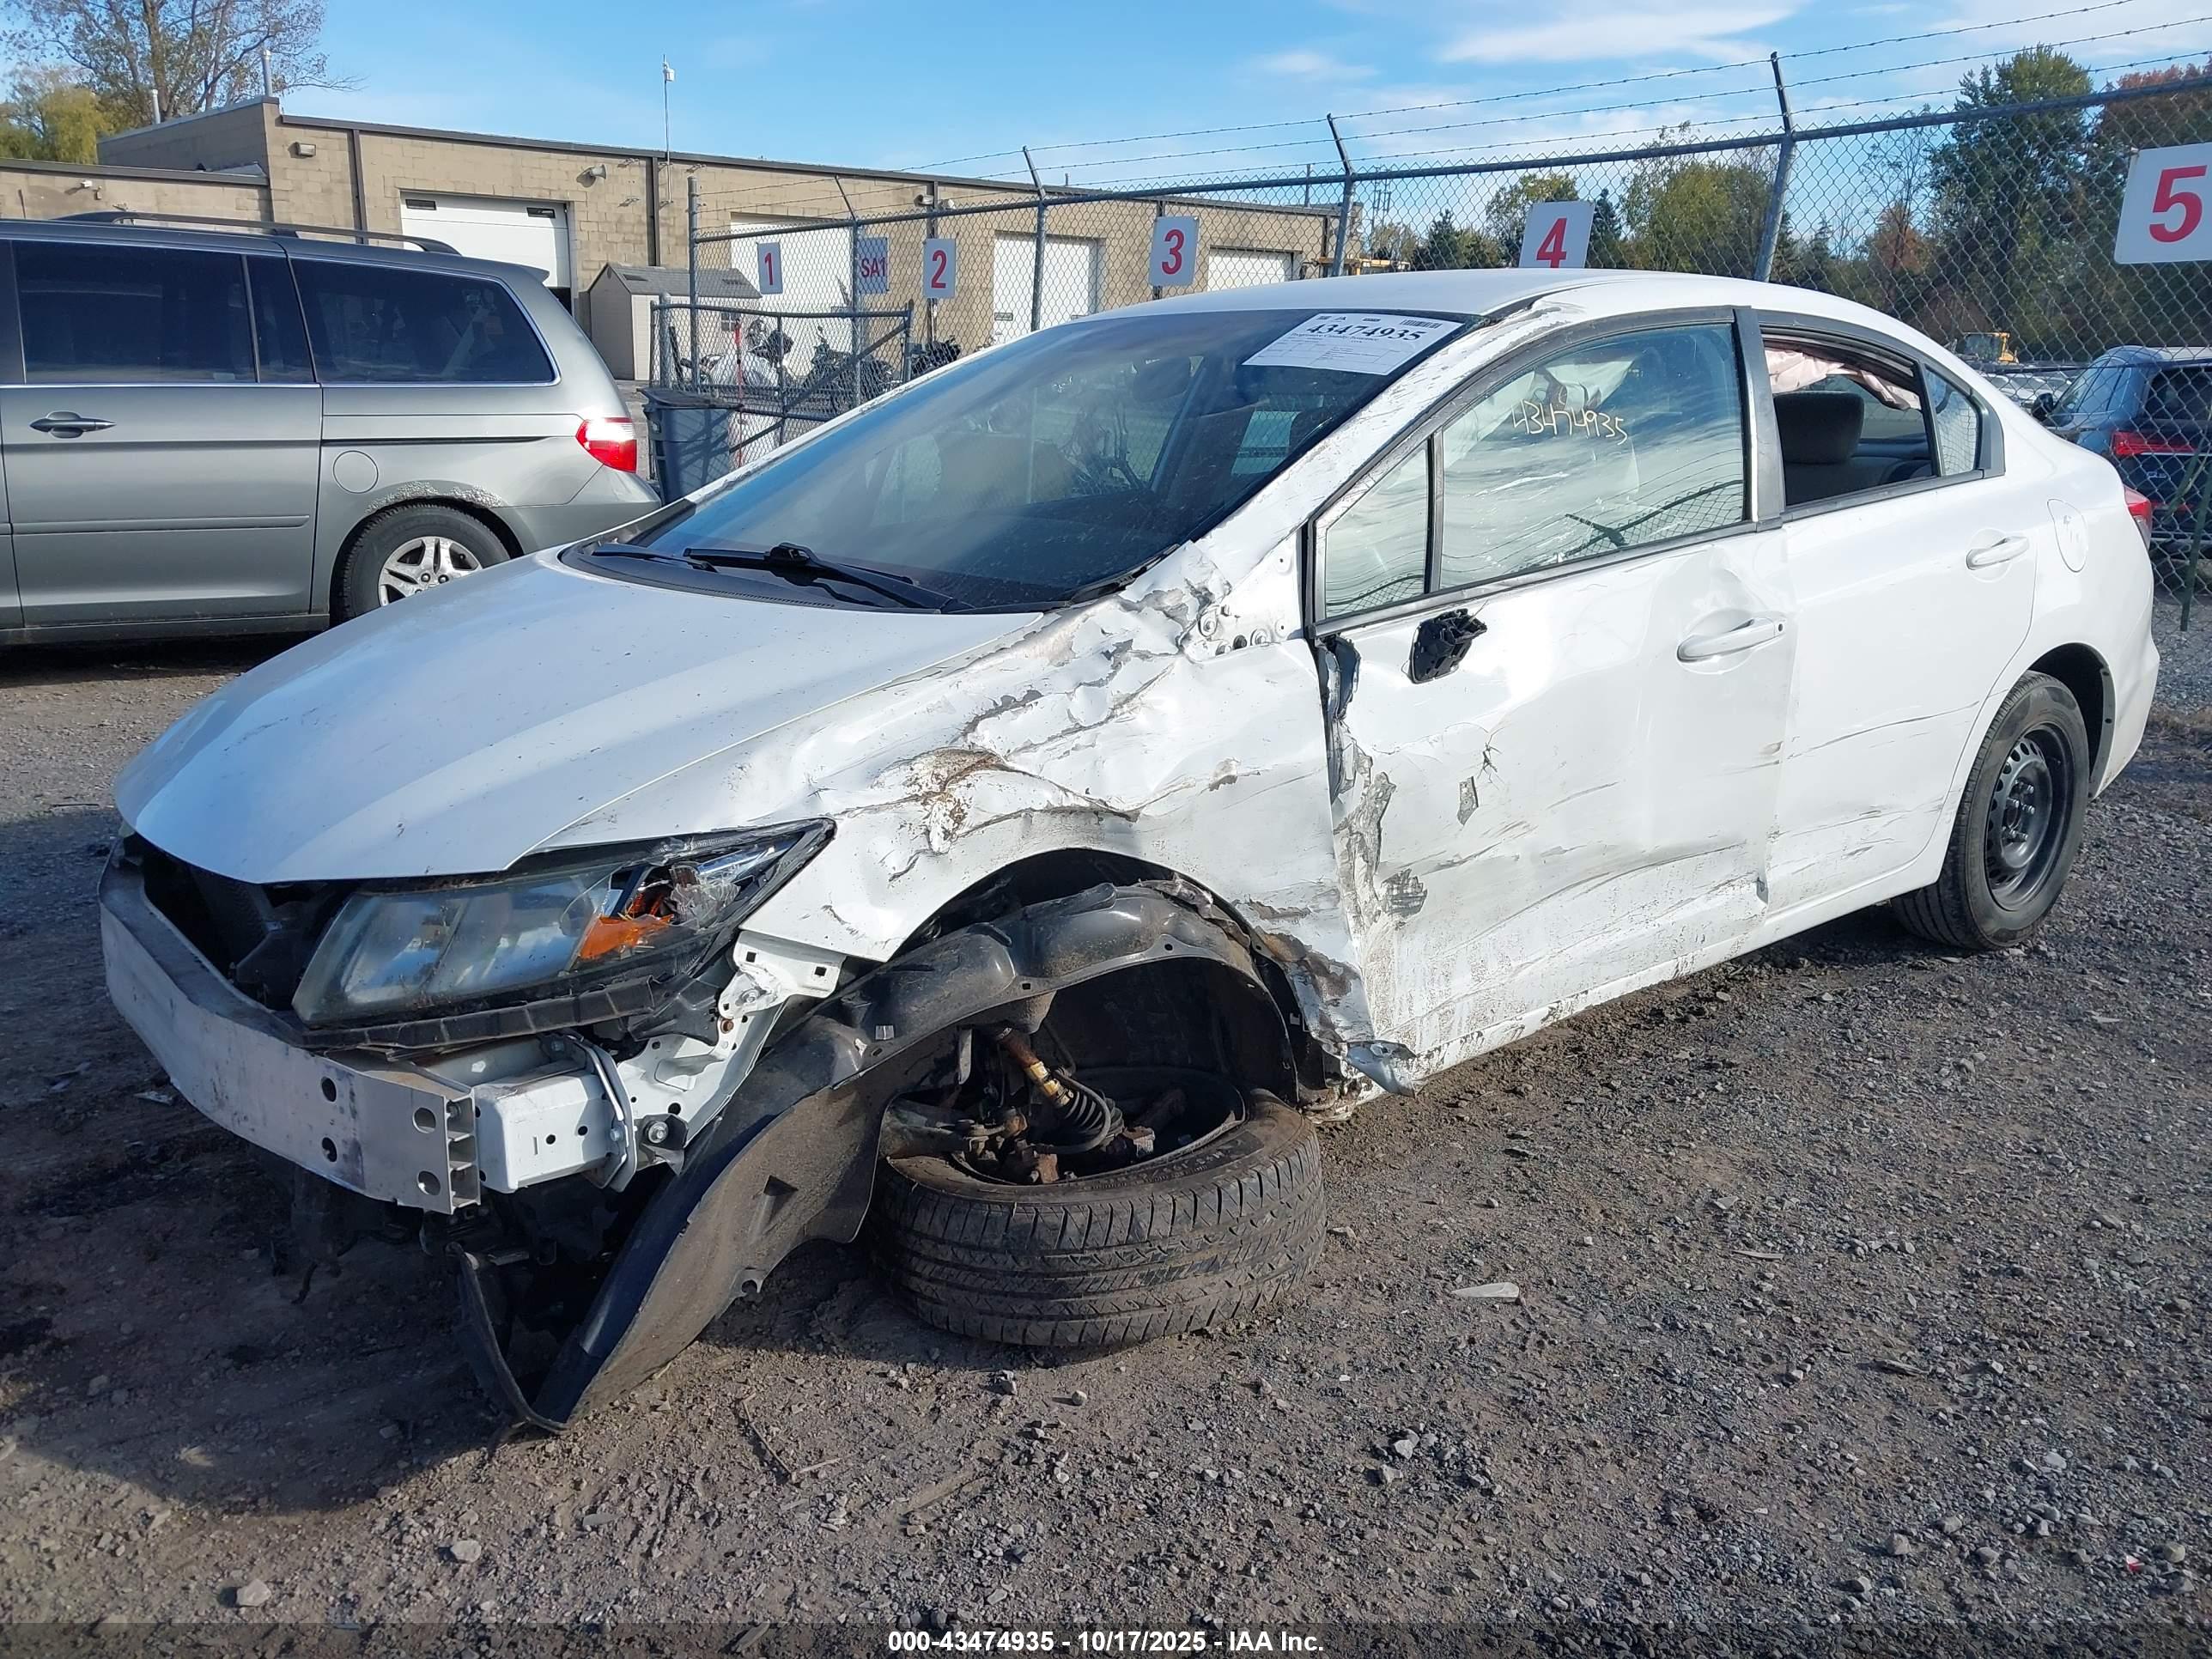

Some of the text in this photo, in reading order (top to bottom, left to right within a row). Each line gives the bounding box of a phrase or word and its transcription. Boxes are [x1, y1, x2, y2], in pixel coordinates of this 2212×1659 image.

[2149, 165, 2208, 243] 5
[1162, 228, 1185, 275] 3
[1535, 217, 1567, 268] 4
[764, 252, 774, 286] 1
[860, 257, 886, 278] SA1
[932, 250, 947, 289] 2
[1306, 324, 1427, 341] 43474935
[1510, 399, 1628, 446] 43474935
